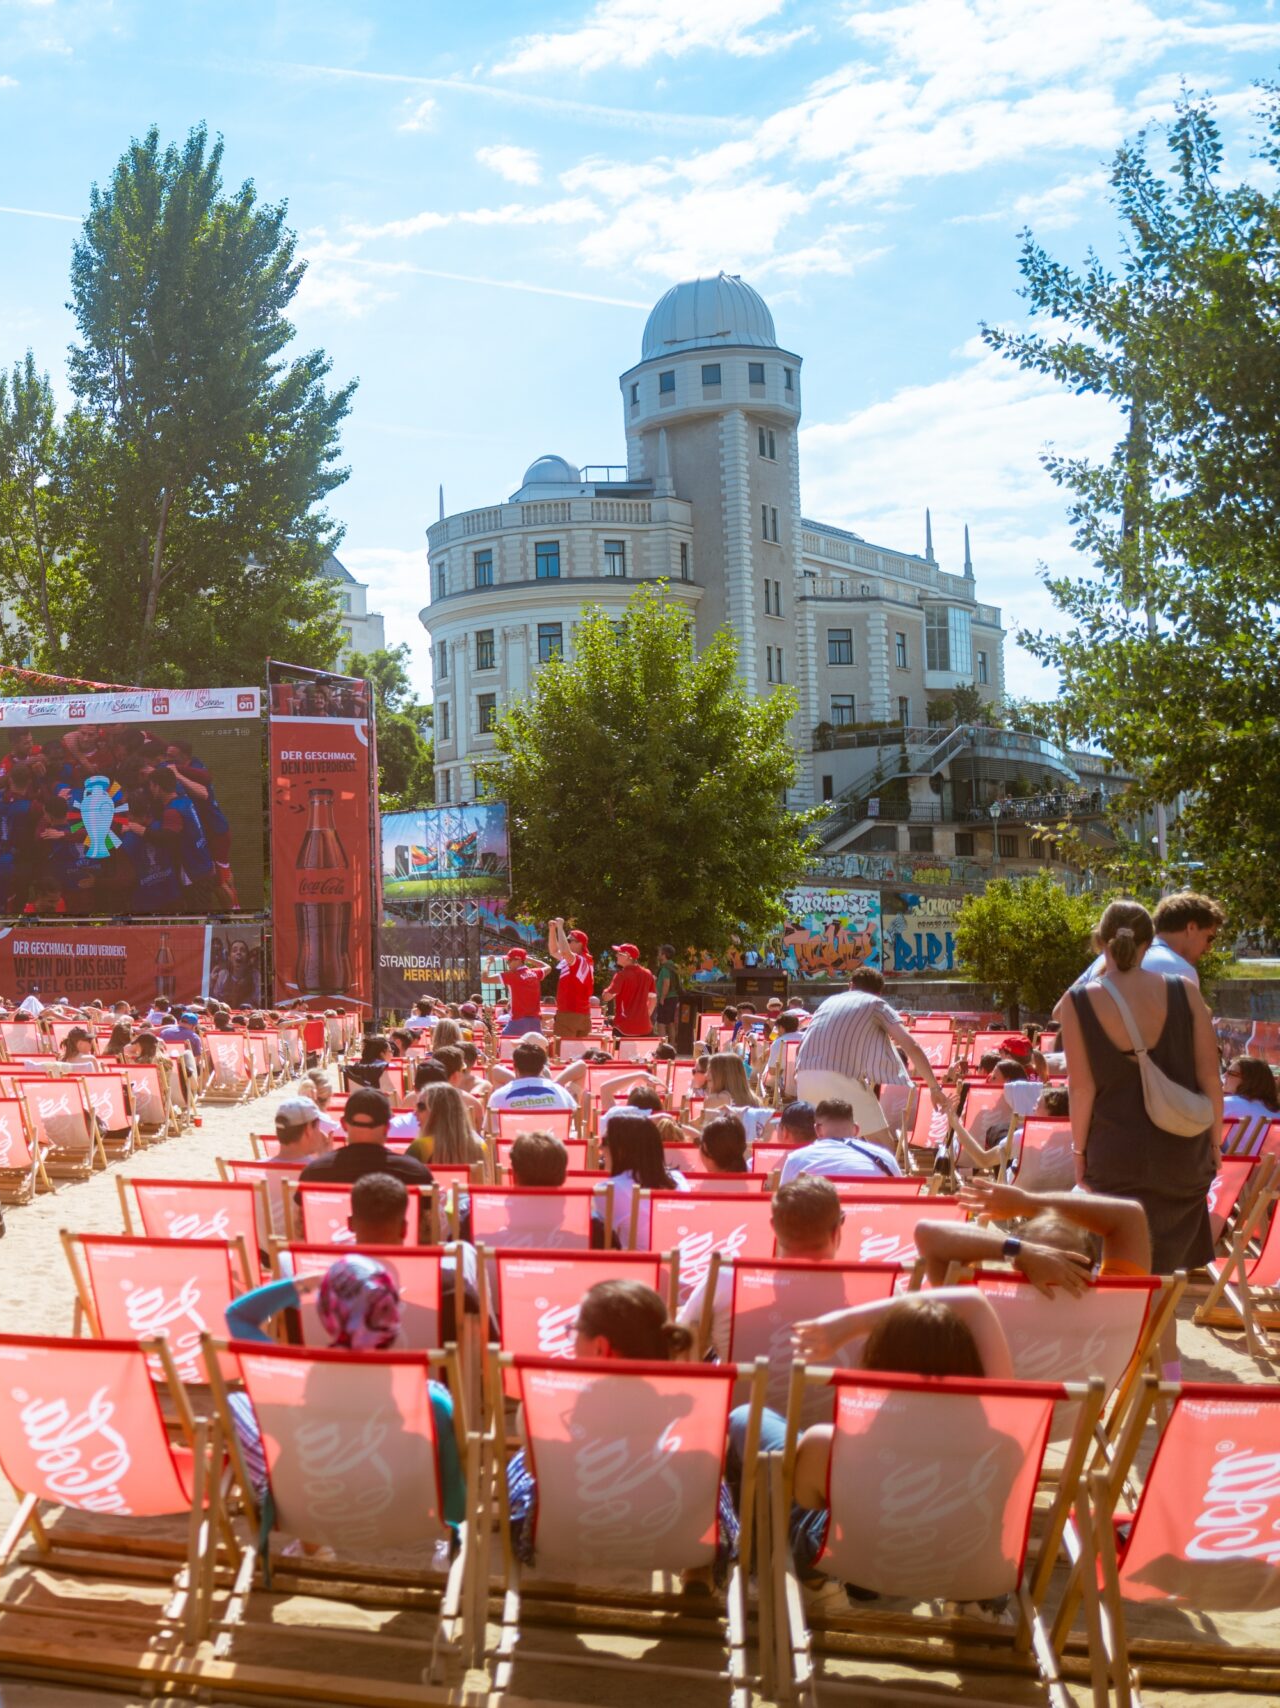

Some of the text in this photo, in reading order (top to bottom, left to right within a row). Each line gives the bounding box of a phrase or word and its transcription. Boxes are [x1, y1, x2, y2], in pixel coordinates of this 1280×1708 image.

[71, 708, 85, 717] on
[153, 705, 168, 713] on
[239, 703, 253, 711] on
[281, 751, 357, 761] DER GESCHMACK,
[281, 761, 300, 775] DEN
[303, 762, 315, 774] DU
[13, 941, 29, 955] DER
[31, 942, 75, 957] GESCHMACK,
[76, 944, 88, 955] DEN
[89, 945, 98, 956] DU
[14, 957, 127, 978] WENN DU DAS GANZE
[379, 955, 441, 968] STRANDBAR
[403, 968, 470, 982] HERRMANN
[16, 977, 128, 995] SPIEL GENIESST.
